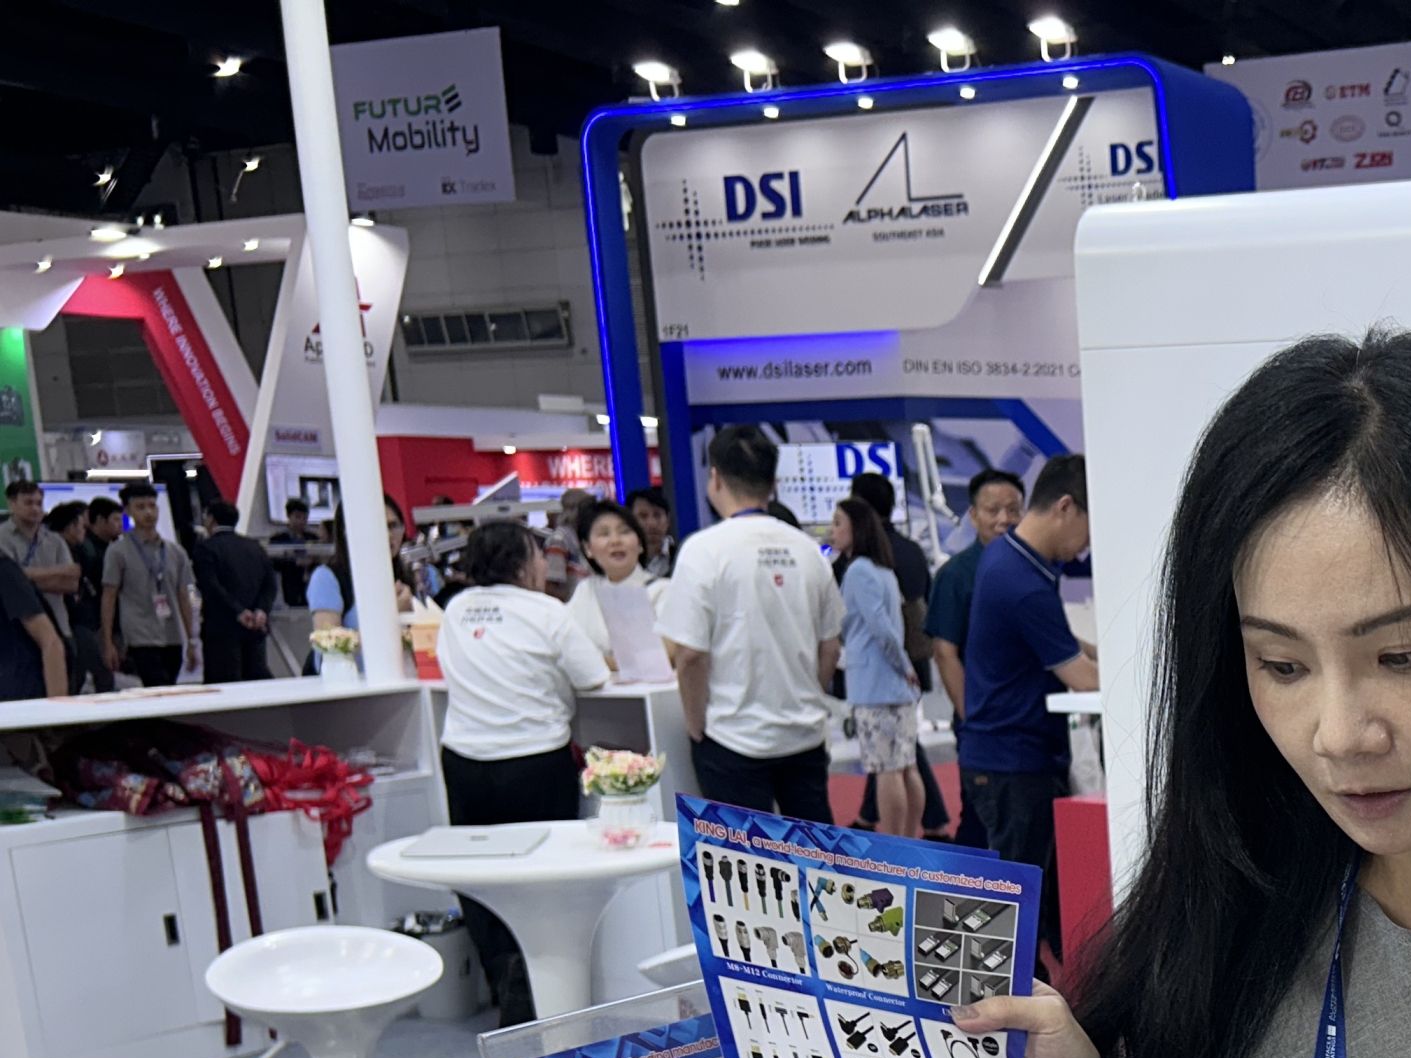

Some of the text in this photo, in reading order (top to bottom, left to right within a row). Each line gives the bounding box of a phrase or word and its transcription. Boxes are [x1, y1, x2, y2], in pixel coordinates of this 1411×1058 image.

[353, 84, 462, 121] FUTURE
[367, 119, 480, 157] Mobility
[723, 170, 803, 223] DSI
[842, 201, 969, 225] ALPHALASER
[872, 228, 945, 242] SOUTHEAST ASIA
[662, 324, 689, 338] 1F21
[152, 287, 242, 457] WHERE INNOVATION BEGINS
[717, 359, 873, 381] www.dsilaser.com
[903, 358, 929, 375] DIN
[931, 359, 954, 375] EN
[956, 360, 982, 376] ISO
[547, 454, 616, 478] WHERE
[694, 818, 1022, 895] KING LAI, a world-leading manufacturer of customized cables
[726, 961, 803, 987] M8-M12 Connector
[825, 983, 907, 1007] Waterproof Connector
